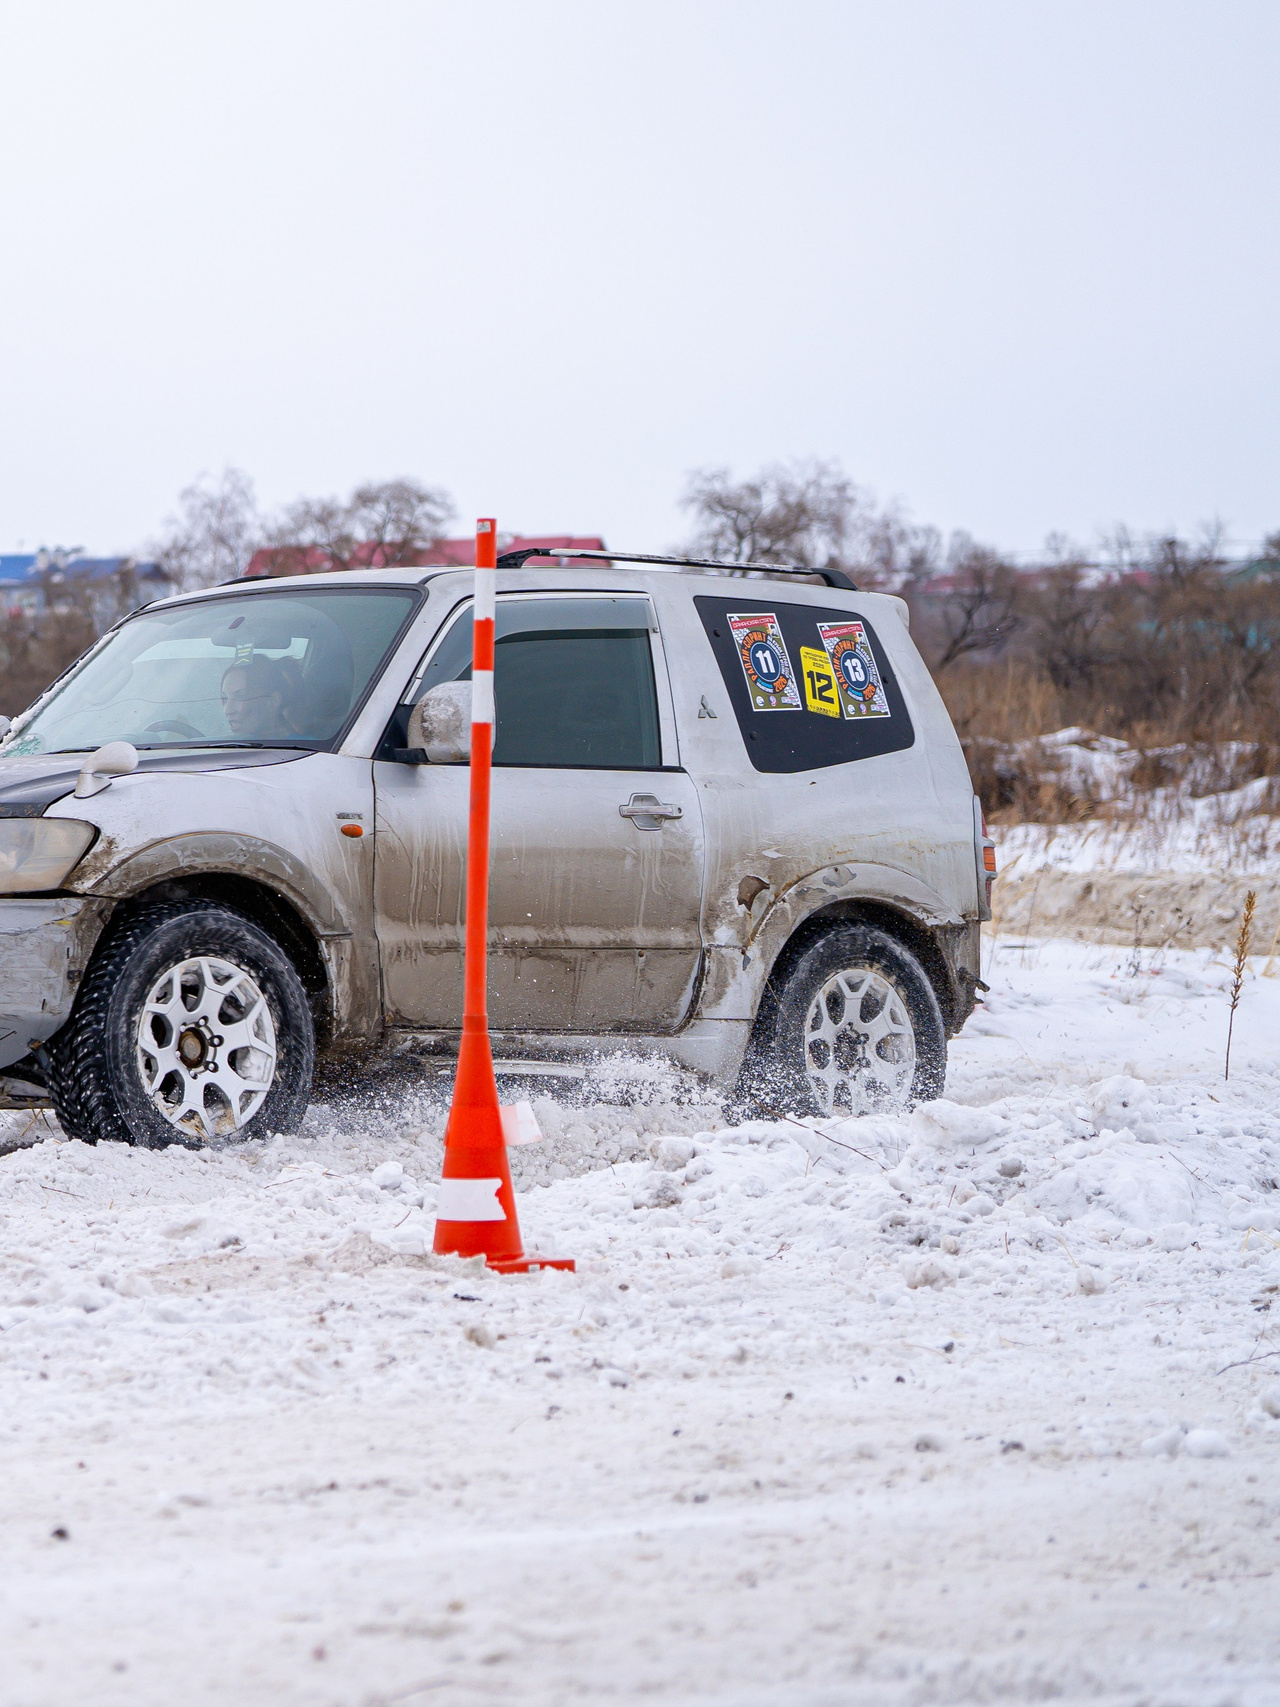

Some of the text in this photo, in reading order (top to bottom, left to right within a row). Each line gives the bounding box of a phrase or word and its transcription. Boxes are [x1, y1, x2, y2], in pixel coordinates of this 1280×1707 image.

[755, 650, 776, 674] 11
[844, 658, 865, 682] 13
[806, 670, 835, 705] 12
